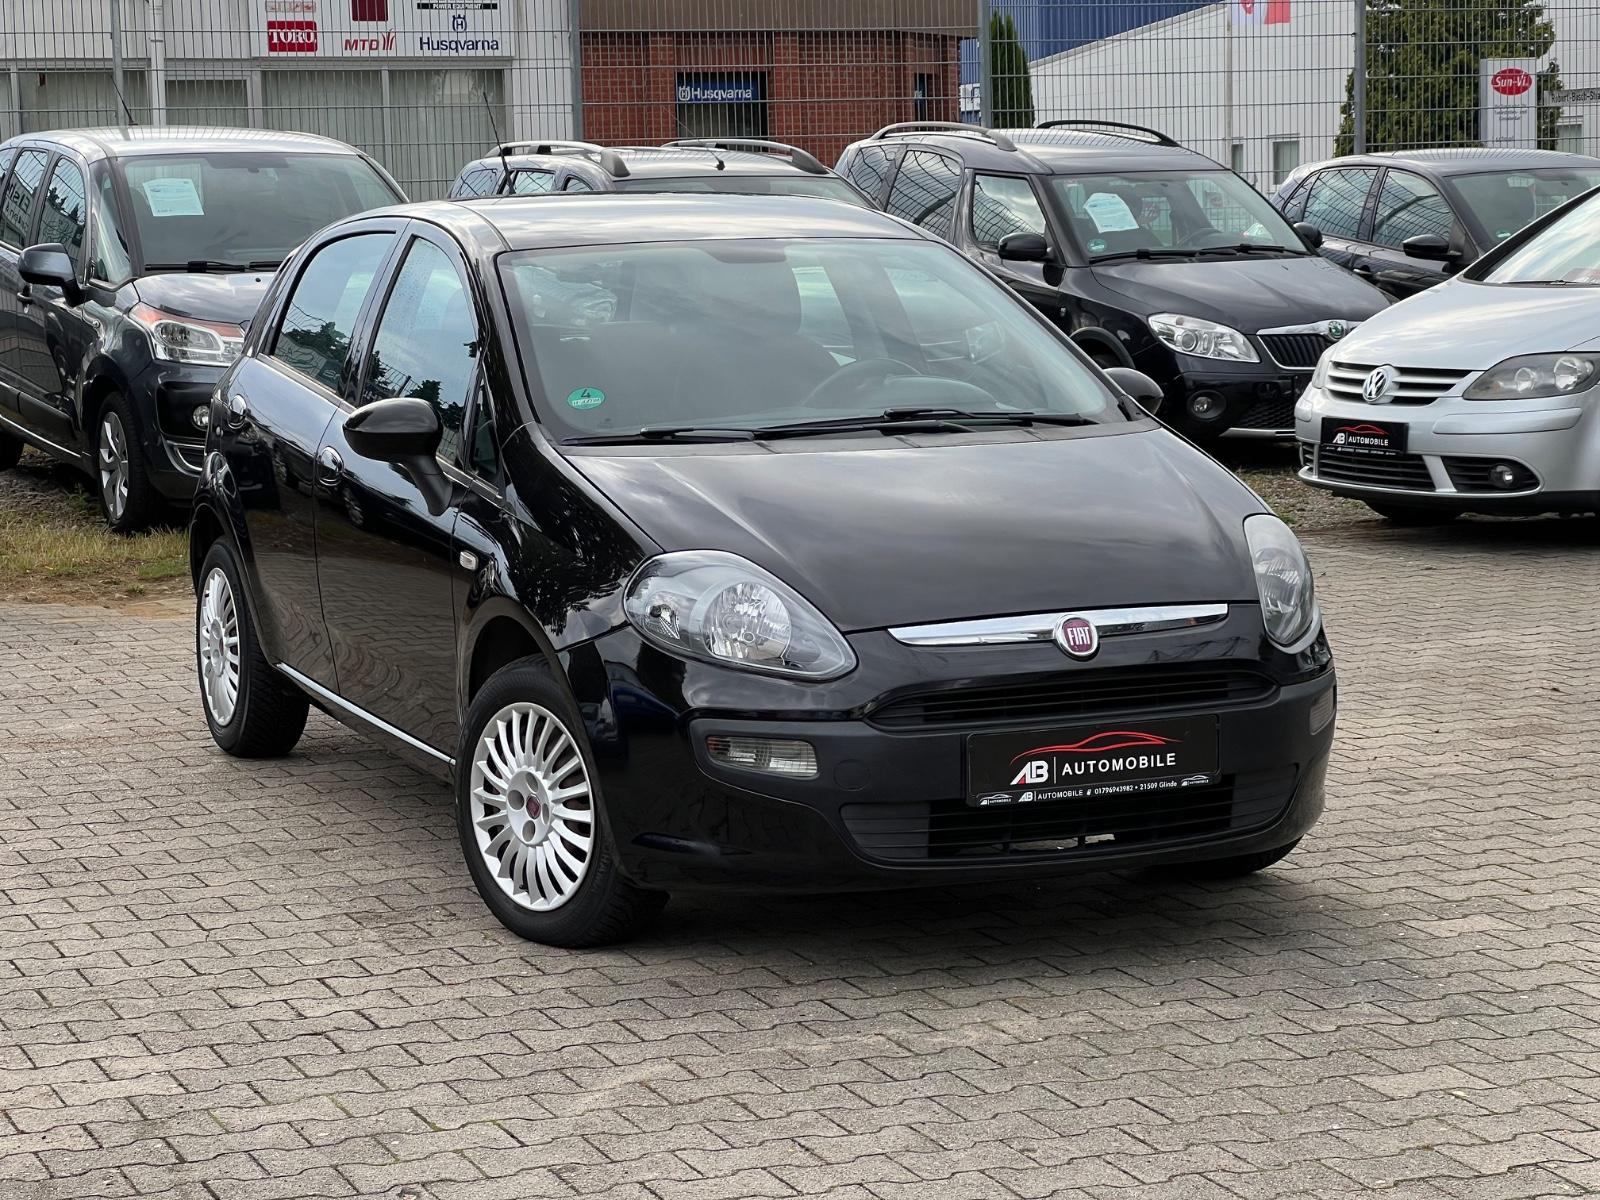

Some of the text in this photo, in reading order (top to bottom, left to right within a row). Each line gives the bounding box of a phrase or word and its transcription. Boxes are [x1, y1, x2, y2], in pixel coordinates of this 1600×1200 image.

[344, 39, 379, 50] MTD
[419, 37, 499, 53] Husqvarna
[691, 88, 752, 100] Husqvarna
[581, 389, 591, 398] 4
[1332, 432, 1389, 446] AB AUTOMOBILE
[1067, 626, 1091, 646] FIAT
[1010, 753, 1177, 786] AB AUTOMOBILE
[1018, 791, 1034, 803] AB
[1037, 789, 1084, 801] AUTOMOBILE
[1140, 781, 1158, 791] 21509
[1159, 779, 1178, 789] Glinde
